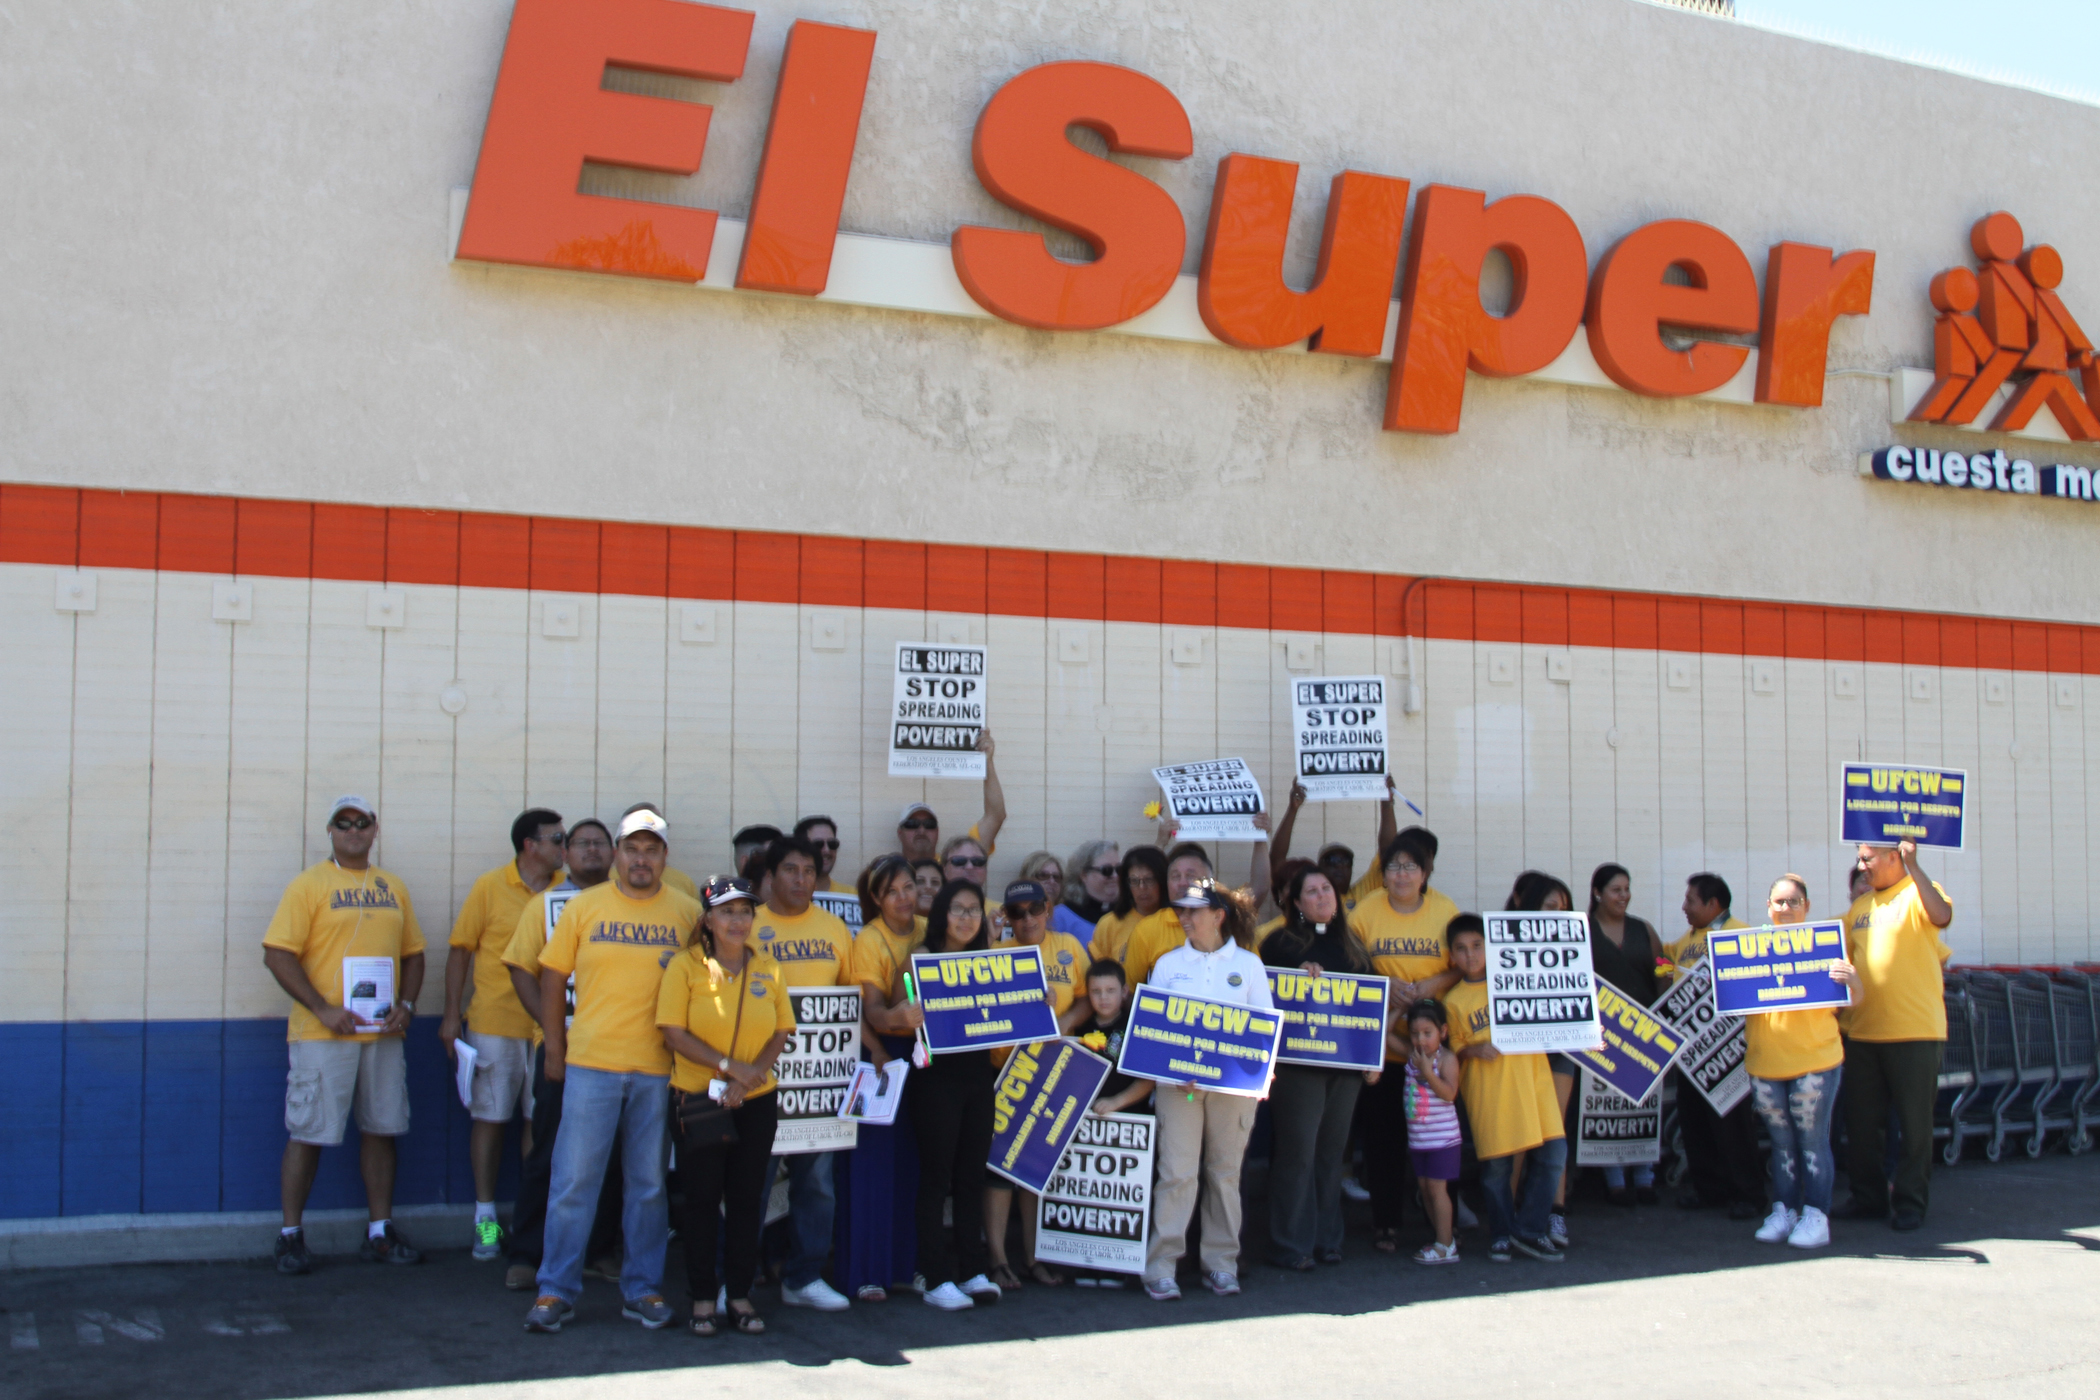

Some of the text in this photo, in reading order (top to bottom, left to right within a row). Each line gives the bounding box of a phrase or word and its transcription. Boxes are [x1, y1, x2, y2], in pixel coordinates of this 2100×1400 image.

[455, 0, 1876, 434] El Super
[1884, 445, 2036, 494] cuesta
[900, 650, 982, 673] EL SUPER
[906, 676, 976, 698] STOP
[1298, 683, 1381, 704] EL SUPER
[898, 700, 981, 719] SPREADING
[1306, 707, 1376, 726] STOP
[897, 725, 979, 747] POVERTY
[1301, 729, 1382, 746] SPREADING
[1157, 760, 1242, 777] EL SUPER
[1302, 752, 1382, 773] POVERTY
[1169, 780, 1254, 794] SPREADING
[1171, 770, 1241, 784] STOP
[1871, 768, 1942, 796] UFCW
[1174, 794, 1257, 814] POVERTY
[1847, 799, 1961, 818] LUCHANDO POR RESPETO
[1903, 813, 1911, 824] Y
[1883, 823, 1928, 838] DIGNIDAD
[1490, 919, 1585, 943] EL SUPER
[1738, 928, 1815, 959] UFCW
[1499, 947, 1579, 969] STOP
[939, 954, 1013, 987] UFCW
[1494, 972, 1589, 991] SPREADING
[1717, 964, 1771, 981] LUCHANDO
[1772, 962, 1794, 976] POR
[1776, 975, 1785, 987] Y
[924, 988, 1044, 1012] LUCHANDO POR RESPETO
[1277, 973, 1358, 1006] UFCW
[1757, 985, 1807, 1001] DIGNIDAD
[801, 996, 858, 1023] SUPER
[981, 1008, 990, 1020] Y
[1166, 995, 1251, 1036] UFCW
[1496, 997, 1590, 1022] POVERTY
[1598, 984, 1662, 1044] UFCW
[964, 1019, 1014, 1037] DIGNIDAD
[1307, 1012, 1329, 1027] POR
[1330, 1014, 1381, 1031] RESPETO
[1309, 1026, 1318, 1038] Y
[781, 1027, 852, 1053] STOP
[1133, 1024, 1271, 1064] LUCHANDO POR RESPETO
[1286, 1037, 1338, 1054] DIGNIDAD
[1680, 1016, 1740, 1067] SPREADIN
[1194, 1050, 1204, 1063] Y
[1603, 1028, 1662, 1076] POR RESPETO
[771, 1057, 856, 1080] SPREADING
[1168, 1058, 1223, 1080] DIGNIDAD
[994, 1050, 1039, 1134] UFCW
[1001, 1044, 1074, 1171] LUCHANDO POR RESPETO
[1043, 1107, 1055, 1119] Y
[1045, 1094, 1078, 1147] DIGNIDAD
[1584, 1116, 1657, 1138] POVERTY
[1078, 1118, 1148, 1150] SUPER
[1059, 1147, 1139, 1177] STOP
[1046, 1174, 1144, 1203] SPREADING
[1044, 1201, 1140, 1236] POVERTY
